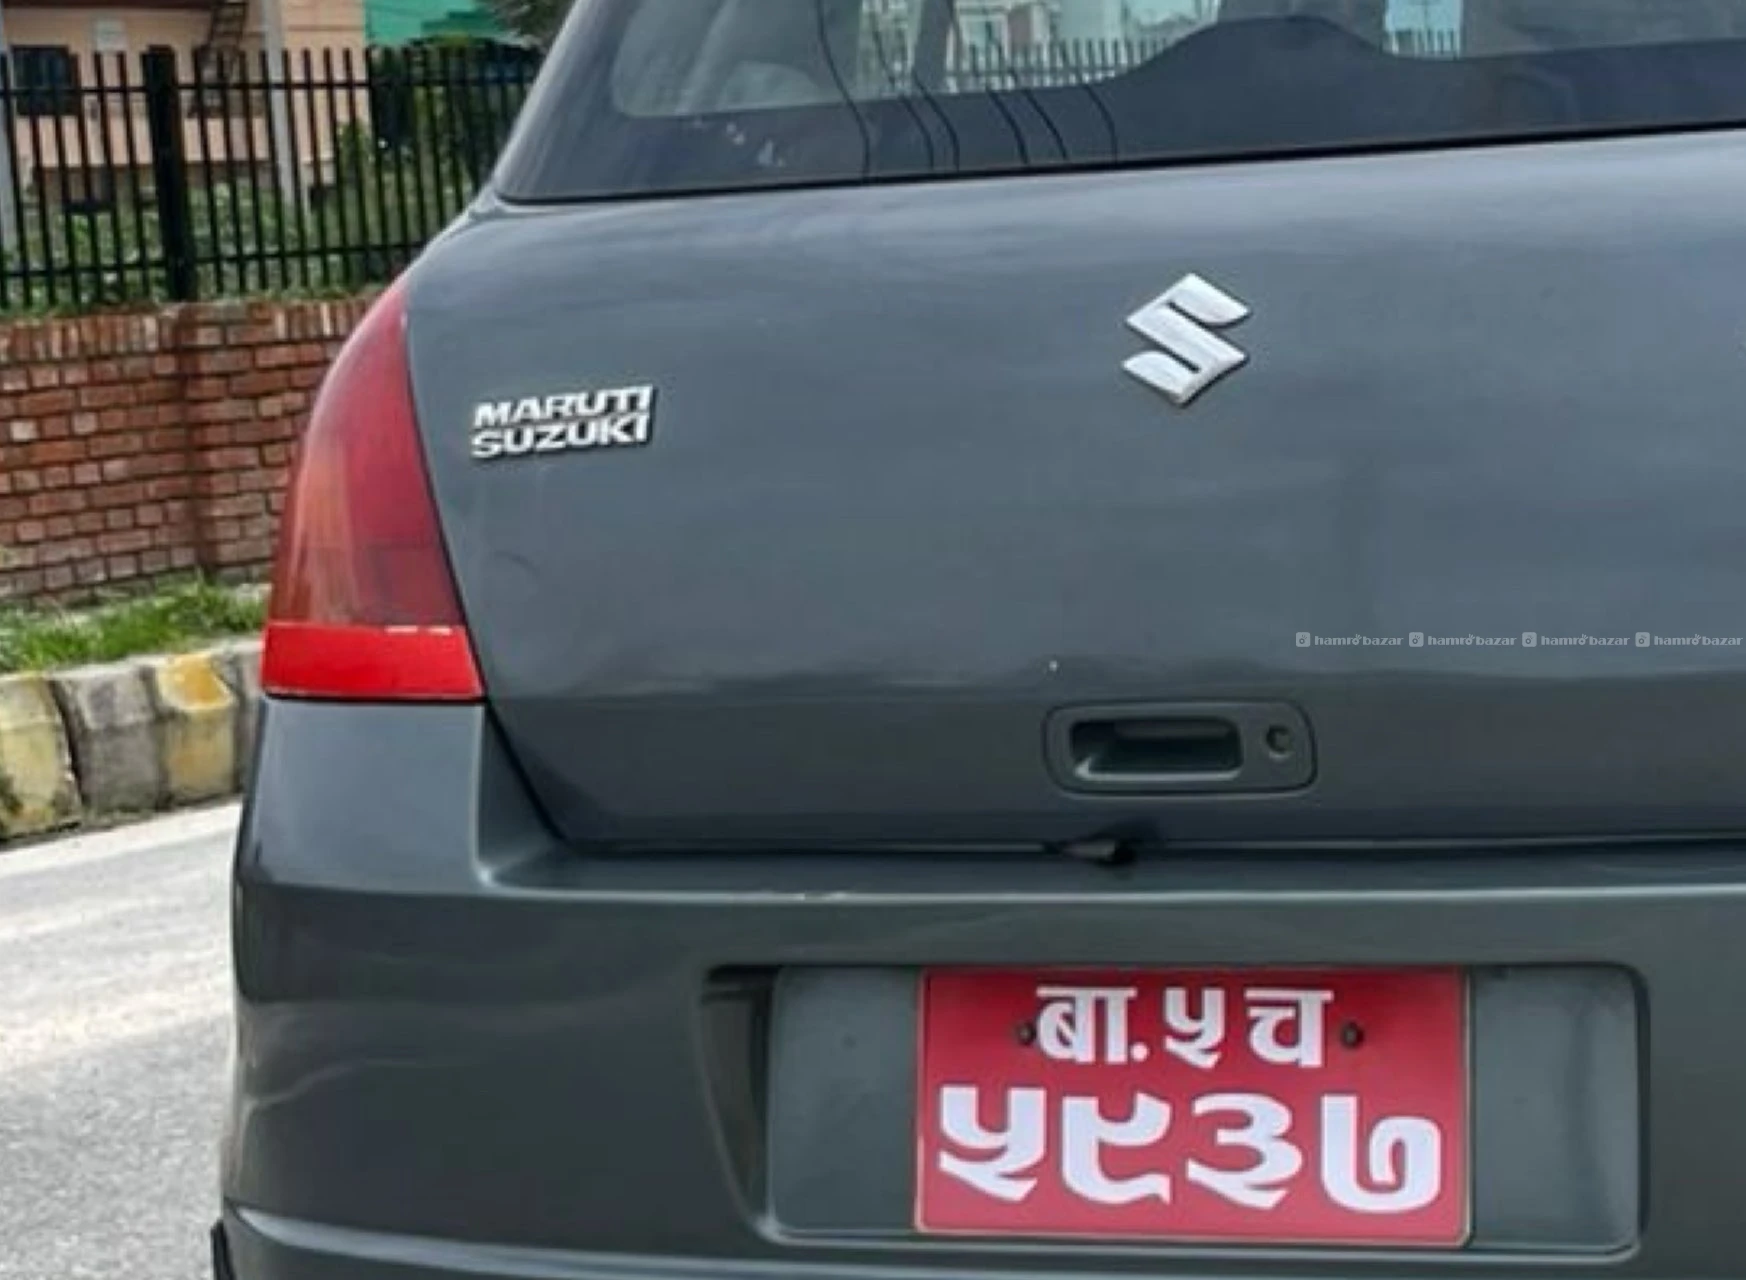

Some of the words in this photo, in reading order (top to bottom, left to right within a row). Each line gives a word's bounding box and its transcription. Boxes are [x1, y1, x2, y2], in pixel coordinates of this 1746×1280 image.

[471, 412, 650, 459] SUZUKI
[474, 384, 654, 427] MARUTI
[1243, 990, 1333, 1068] च
[938, 1085, 1442, 1215] ५९३७
